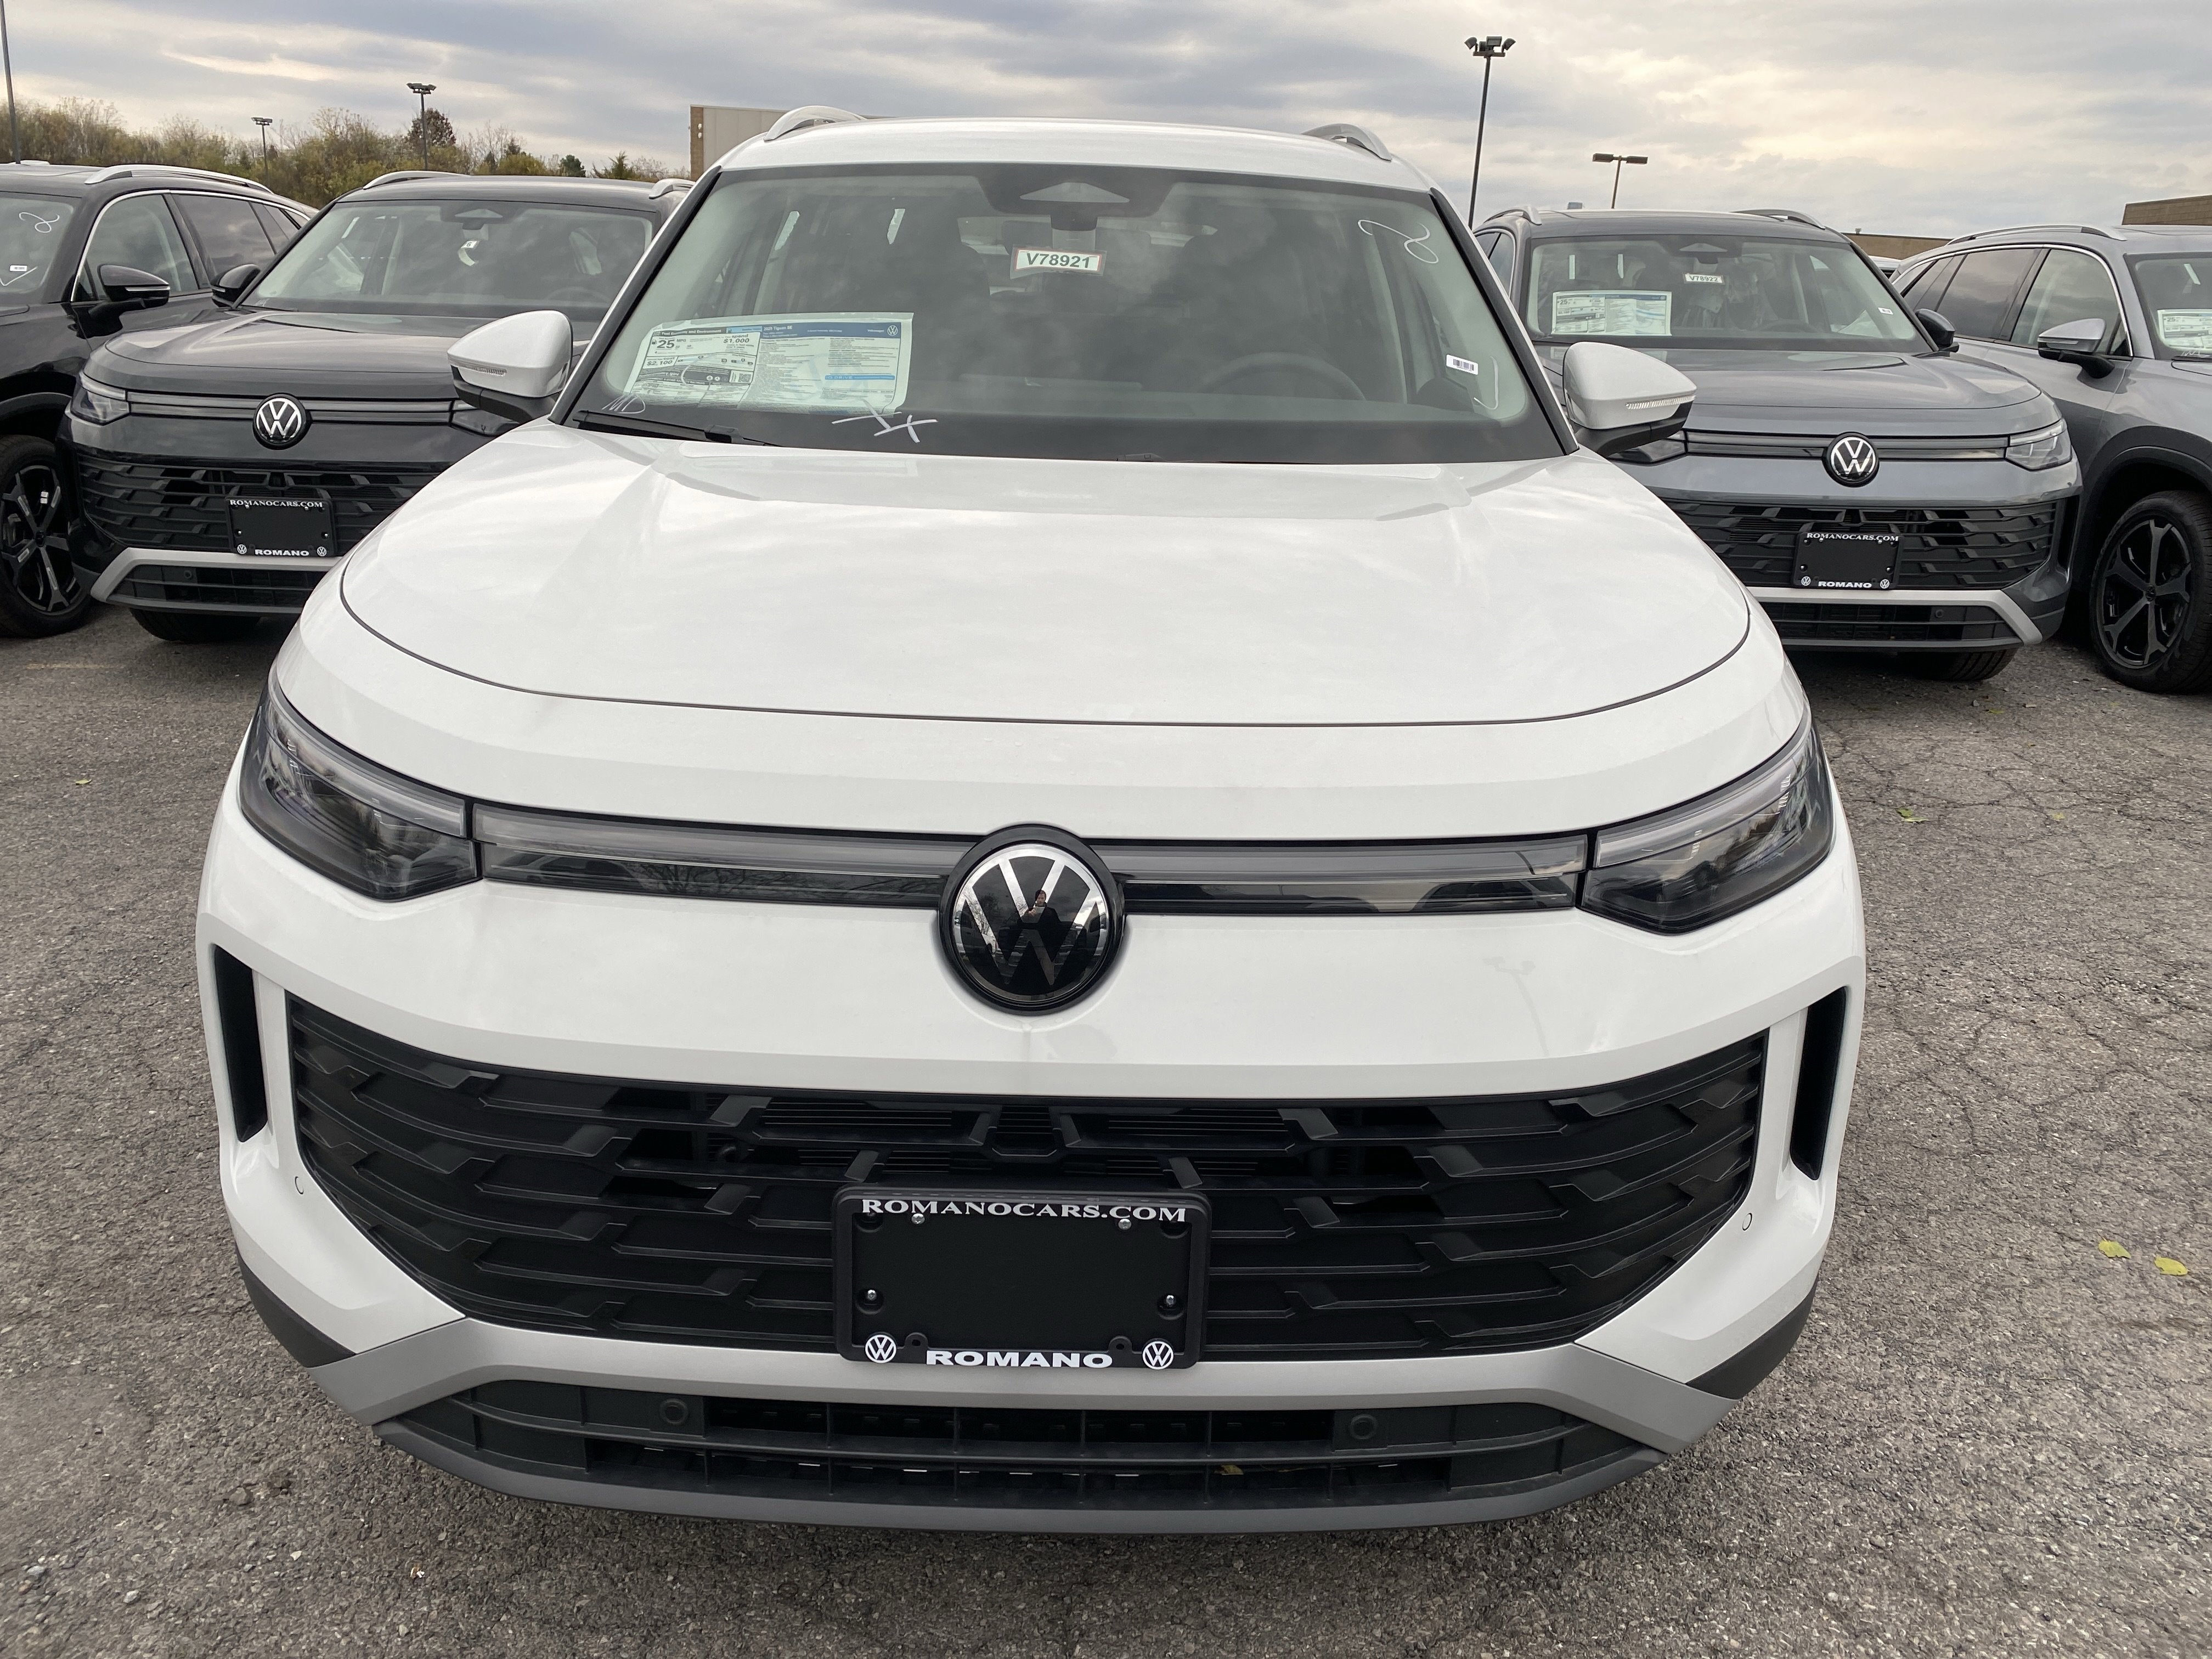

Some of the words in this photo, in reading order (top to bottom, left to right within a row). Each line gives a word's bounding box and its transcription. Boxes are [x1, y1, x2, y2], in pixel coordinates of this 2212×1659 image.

[1026, 252, 1090, 268] V78921
[657, 340, 675, 348] 25
[1807, 533, 1899, 541] ROMANOCARS.COM
[862, 1199, 1186, 1222] ROMANOCARS.COM
[926, 1350, 1113, 1368] ROMANO
